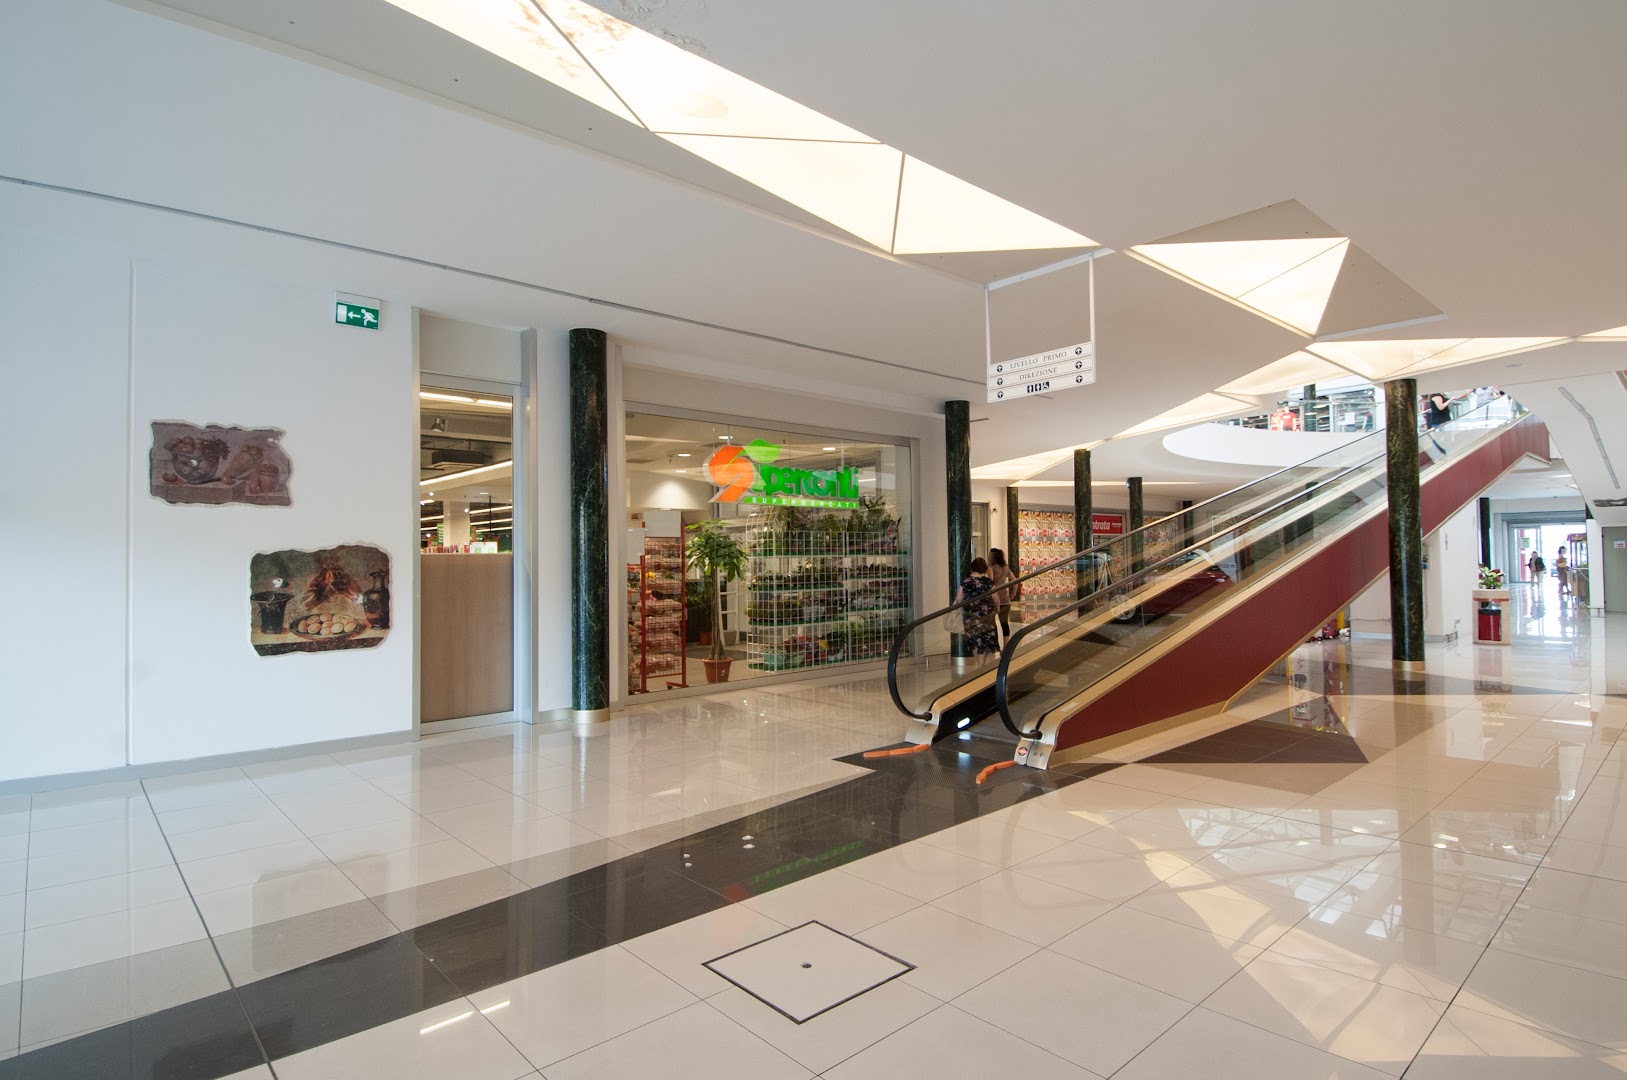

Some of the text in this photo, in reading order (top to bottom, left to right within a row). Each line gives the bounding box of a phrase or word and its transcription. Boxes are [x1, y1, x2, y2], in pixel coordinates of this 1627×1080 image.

[1009, 351, 1067, 369] LIVELLO PRIMO
[1019, 367, 1058, 381] DIREZIONE
[751, 496, 857, 508] SUPERMERCATI
[1092, 520, 1110, 530] ntrata
